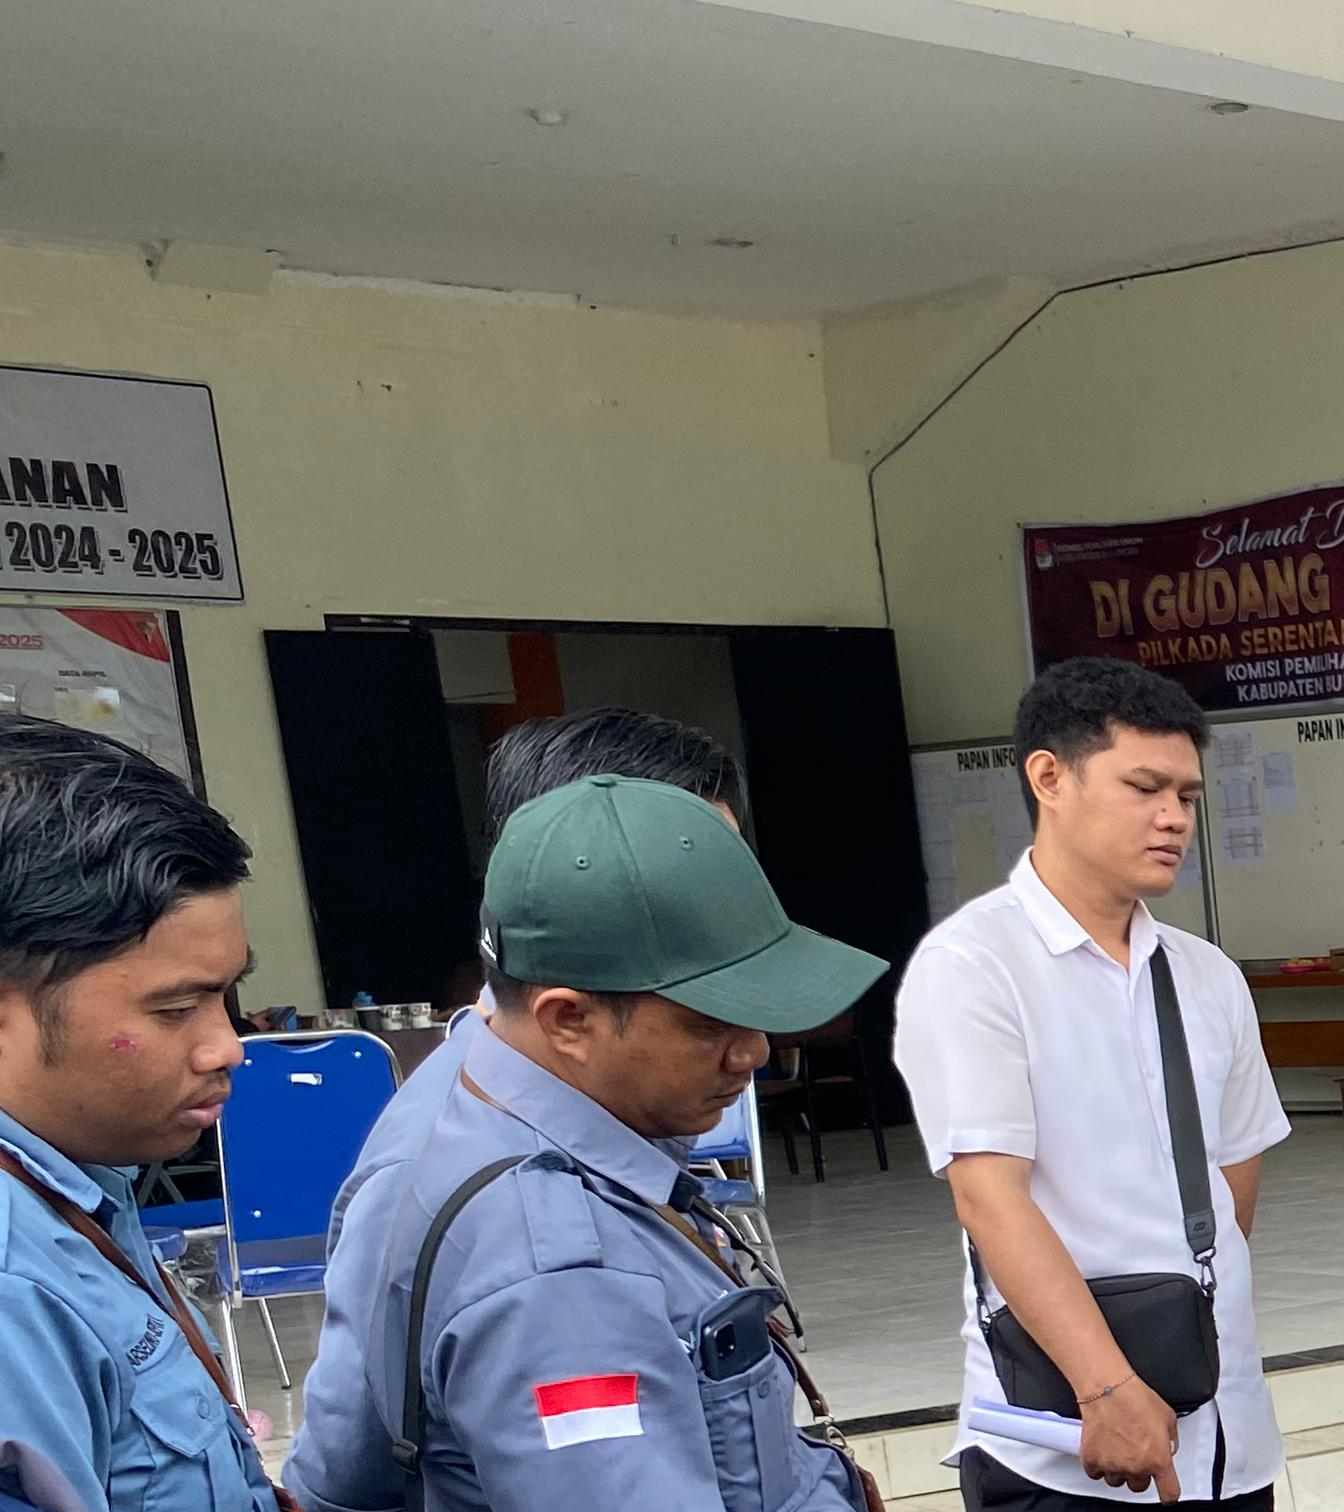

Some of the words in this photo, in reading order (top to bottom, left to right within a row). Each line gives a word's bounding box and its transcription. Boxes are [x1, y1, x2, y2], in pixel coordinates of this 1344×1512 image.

[5, 521, 104, 575] 2024
[127, 528, 224, 580] 2025
[1196, 506, 1316, 568] Selamat
[1088, 578, 1135, 638] DI
[1143, 552, 1330, 632] GUDANG
[1137, 632, 1233, 667] PILKADA
[1225, 657, 1281, 682] KOMISI
[1237, 676, 1325, 702] KABUPATEN
[1297, 719, 1334, 744] PAPAN
[957, 750, 989, 772] PAPAN
